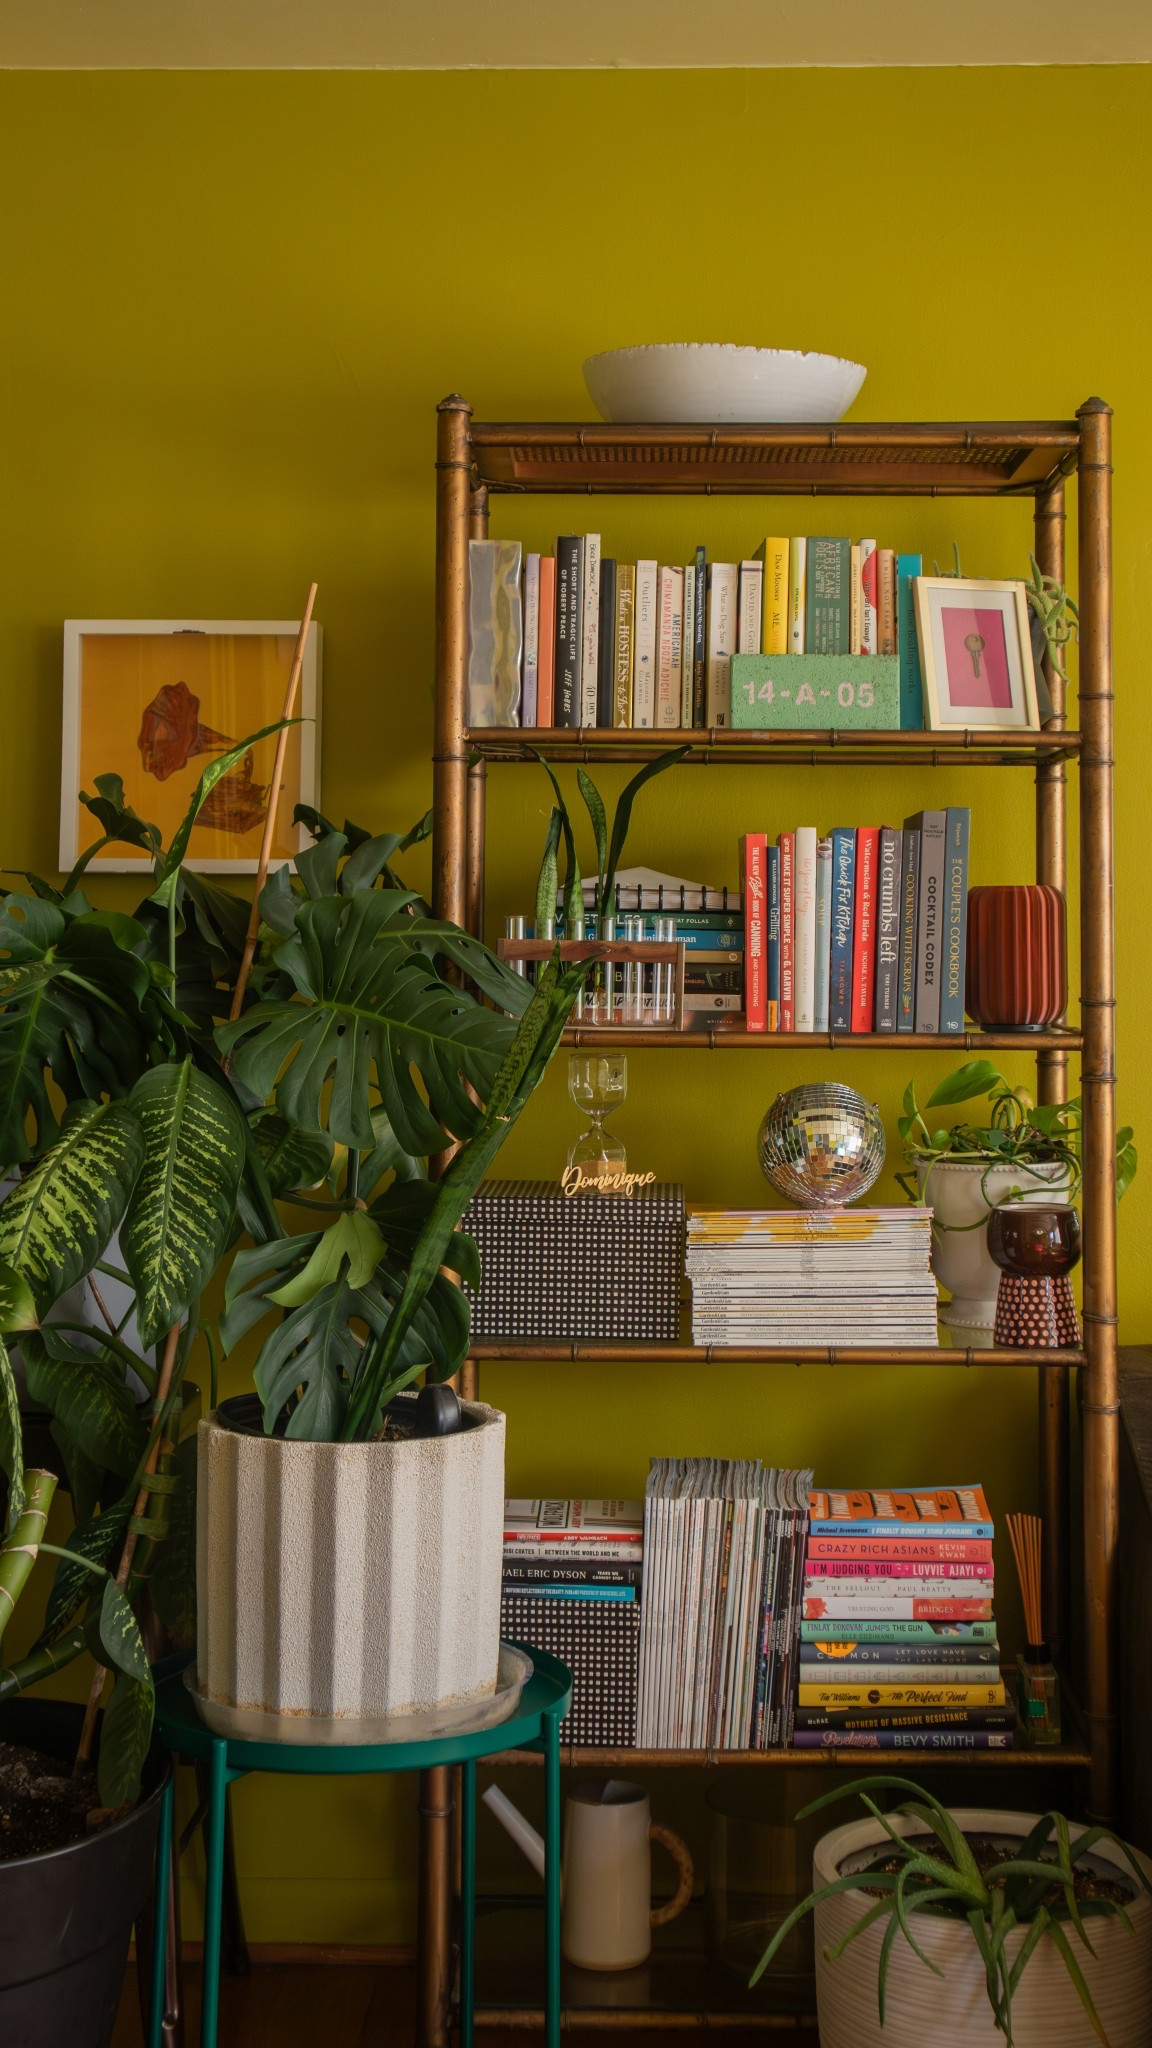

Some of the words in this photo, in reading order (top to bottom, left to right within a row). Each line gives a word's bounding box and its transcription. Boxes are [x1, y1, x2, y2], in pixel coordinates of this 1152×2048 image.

[816, 541, 826, 570] POETS
[825, 542, 835, 593] AFRICAN
[561, 570, 567, 579] OF
[641, 581, 651, 622] Outliers
[663, 579, 672, 635] CHIMAMANDA
[718, 614, 726, 629] Dog
[772, 612, 780, 628] ME,
[907, 609, 915, 627] how
[618, 625, 629, 681] HOSTESS
[662, 639, 671, 665] NGOZI
[671, 614, 680, 668] AMERICANAH
[905, 630, 916, 665] healing
[586, 684, 596, 697] 40
[661, 668, 670, 701] ADICHIE
[743, 679, 876, 708] 14-A-05
[840, 837, 853, 854] The
[883, 841, 896, 863] no
[835, 856, 850, 885] Quick
[862, 838, 872, 890] Watermelon
[838, 887, 850, 901] Fix
[880, 867, 897, 931] crumbs
[905, 874, 915, 924] COOKING
[926, 876, 936, 939] COCKTAIL
[951, 866, 962, 923] COUPLE'S
[817, 899, 825, 926] SOUP
[862, 902, 871, 917] Red
[750, 920, 761, 956] CANNING
[769, 908, 779, 940] Grilling
[836, 905, 851, 947] Kitchen
[862, 919, 870, 941] Birds
[880, 936, 896, 964] left
[904, 926, 913, 954] WITH
[903, 956, 912, 992] SCRAPS
[924, 943, 935, 986] CODEX
[948, 927, 961, 998] COOKBOOK
[561, 1166, 656, 1196] Dominique
[818, 1544, 856, 1553] CRAZY
[860, 1545, 889, 1554] RICH
[892, 1546, 936, 1555] ASIANS
[527, 1569, 550, 1578] ERIC
[553, 1570, 586, 1579] DYSON
[813, 1565, 827, 1575] I'M
[832, 1566, 870, 1575] JUDGING
[875, 1566, 892, 1575] YOU
[913, 1565, 945, 1576] LUVVIE
[949, 1566, 974, 1577] AJAYI
[918, 1606, 954, 1614] BRIDGES
[833, 1624, 863, 1632] DONOVAN
[819, 1693, 830, 1702] Tia
[831, 1693, 861, 1702] Williams
[906, 1689, 943, 1702] Perfect
[946, 1691, 969, 1702] Find
[845, 1720, 880, 1729] MOTHERS
[881, 1719, 890, 1727] OF
[892, 1716, 924, 1726] MASSIVE
[925, 1712, 968, 1724] RESISTANCE
[894, 1735, 928, 1747] BEVY
[933, 1735, 975, 1747] SMITH
